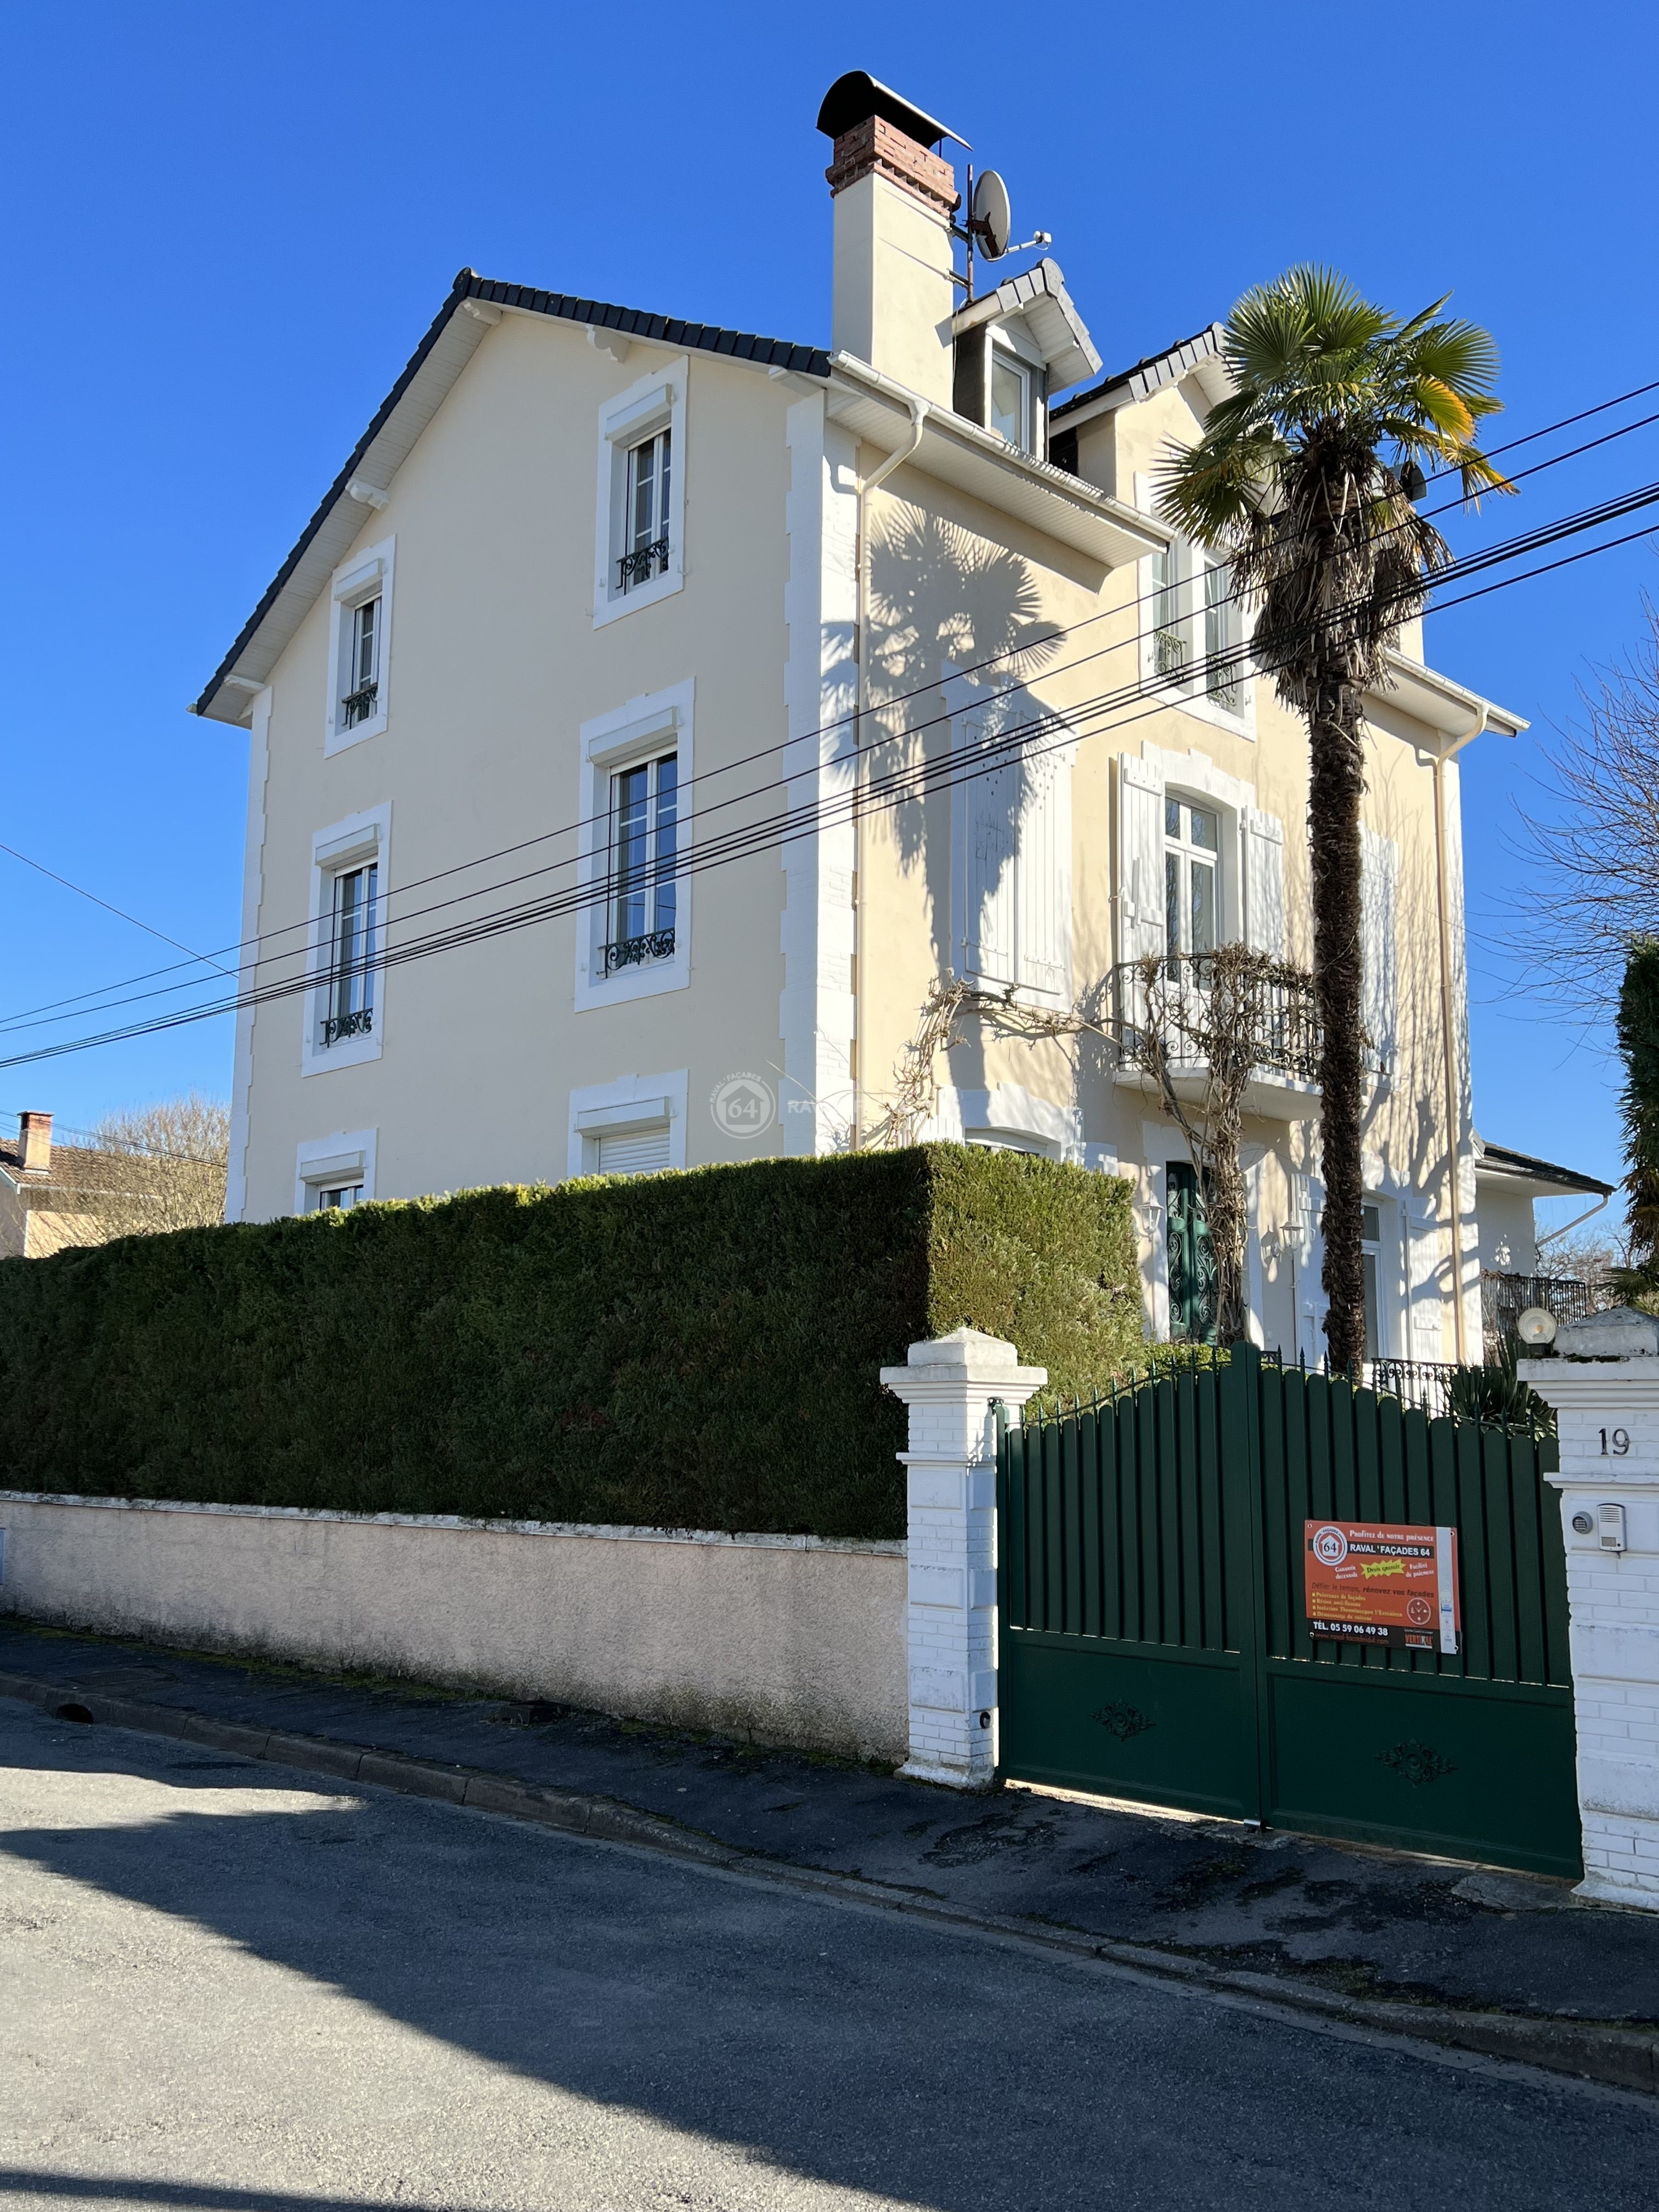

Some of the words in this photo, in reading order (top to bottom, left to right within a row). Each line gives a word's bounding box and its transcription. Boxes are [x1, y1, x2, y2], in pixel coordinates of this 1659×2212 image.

[1598, 1428, 1629, 1455] 19
[1324, 1542, 1336, 1553] 64
[1350, 1544, 1375, 1553] RAVAL
[1420, 1548, 1430, 1556] 64
[1363, 1585, 1391, 1594] rénovez
[1407, 1589, 1434, 1598] façades
[1313, 1620, 1328, 1630] TÉL.
[1330, 1623, 1340, 1632] 05
[1342, 1624, 1352, 1633] 59
[1353, 1625, 1364, 1634] 06
[1365, 1626, 1376, 1635] 49
[1378, 1627, 1388, 1636] 38
